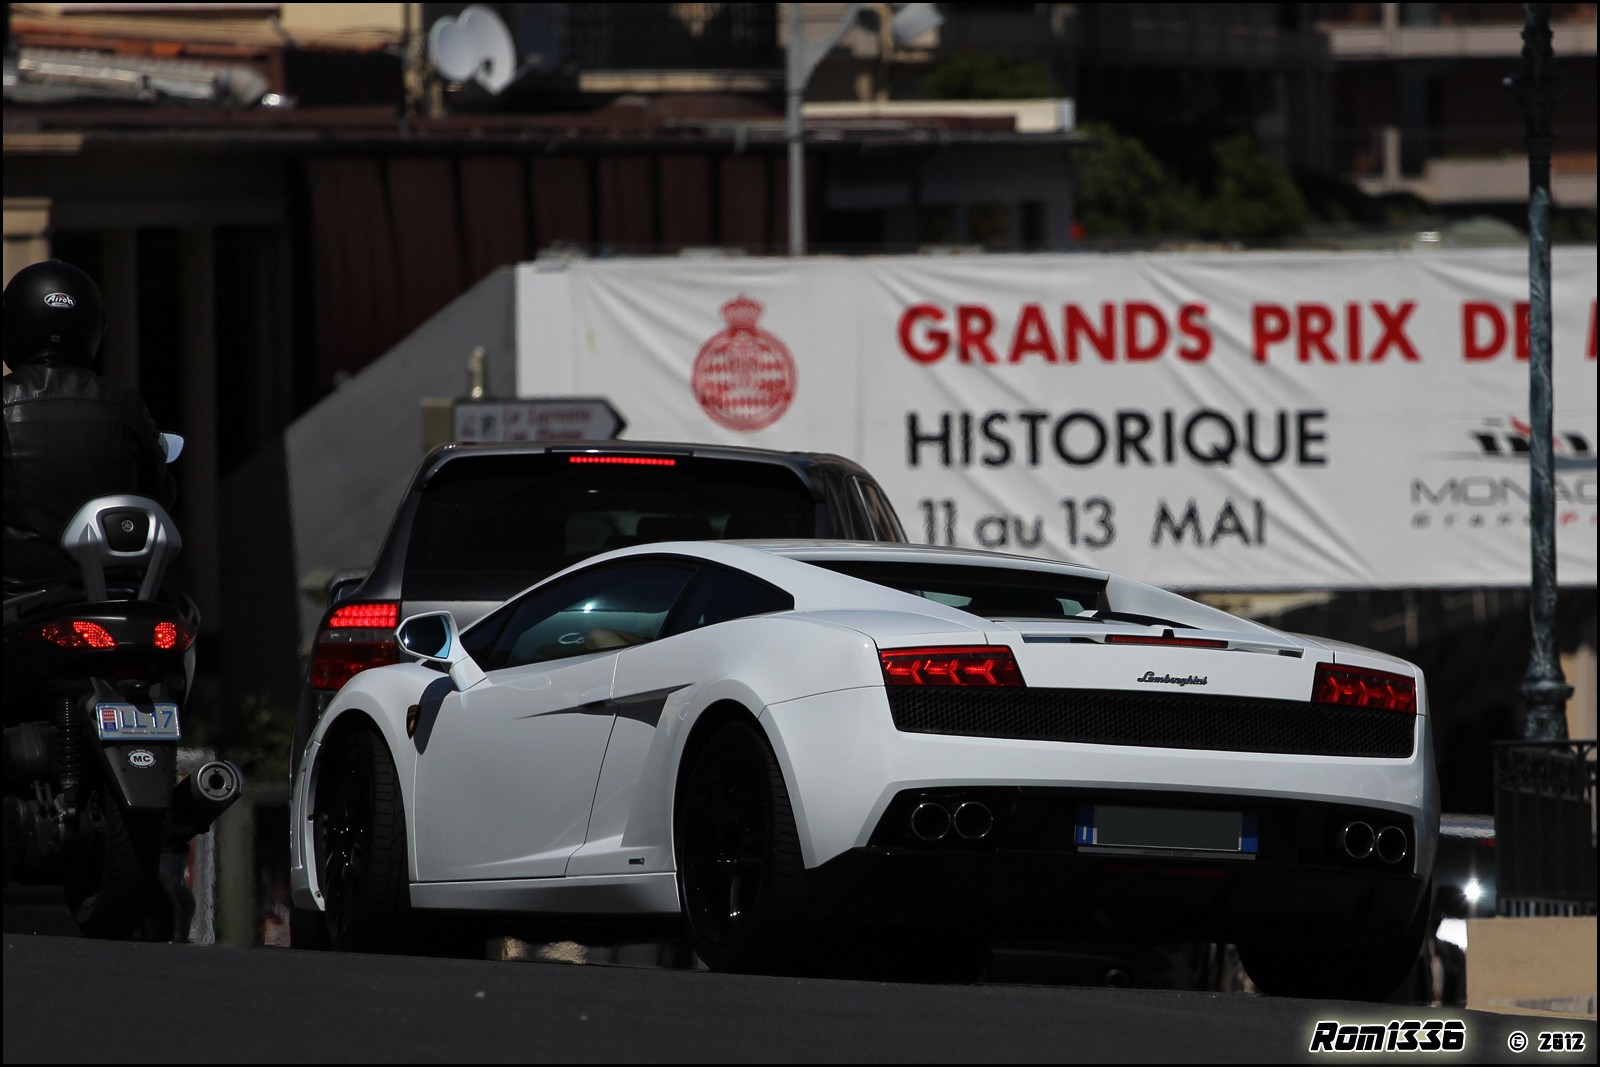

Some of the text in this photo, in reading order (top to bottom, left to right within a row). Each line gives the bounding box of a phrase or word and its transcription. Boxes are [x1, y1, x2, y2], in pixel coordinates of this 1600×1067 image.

[47, 294, 74, 306] Airoh
[898, 301, 1213, 365] GRANDS
[1252, 301, 1422, 364] PRIX
[906, 408, 1327, 467] HISTORIQUE
[917, 497, 1266, 549] 11 au 13 MAI
[1136, 671, 1207, 686] Lamborghini
[119, 710, 173, 728] LL17
[133, 755, 150, 763] MC
